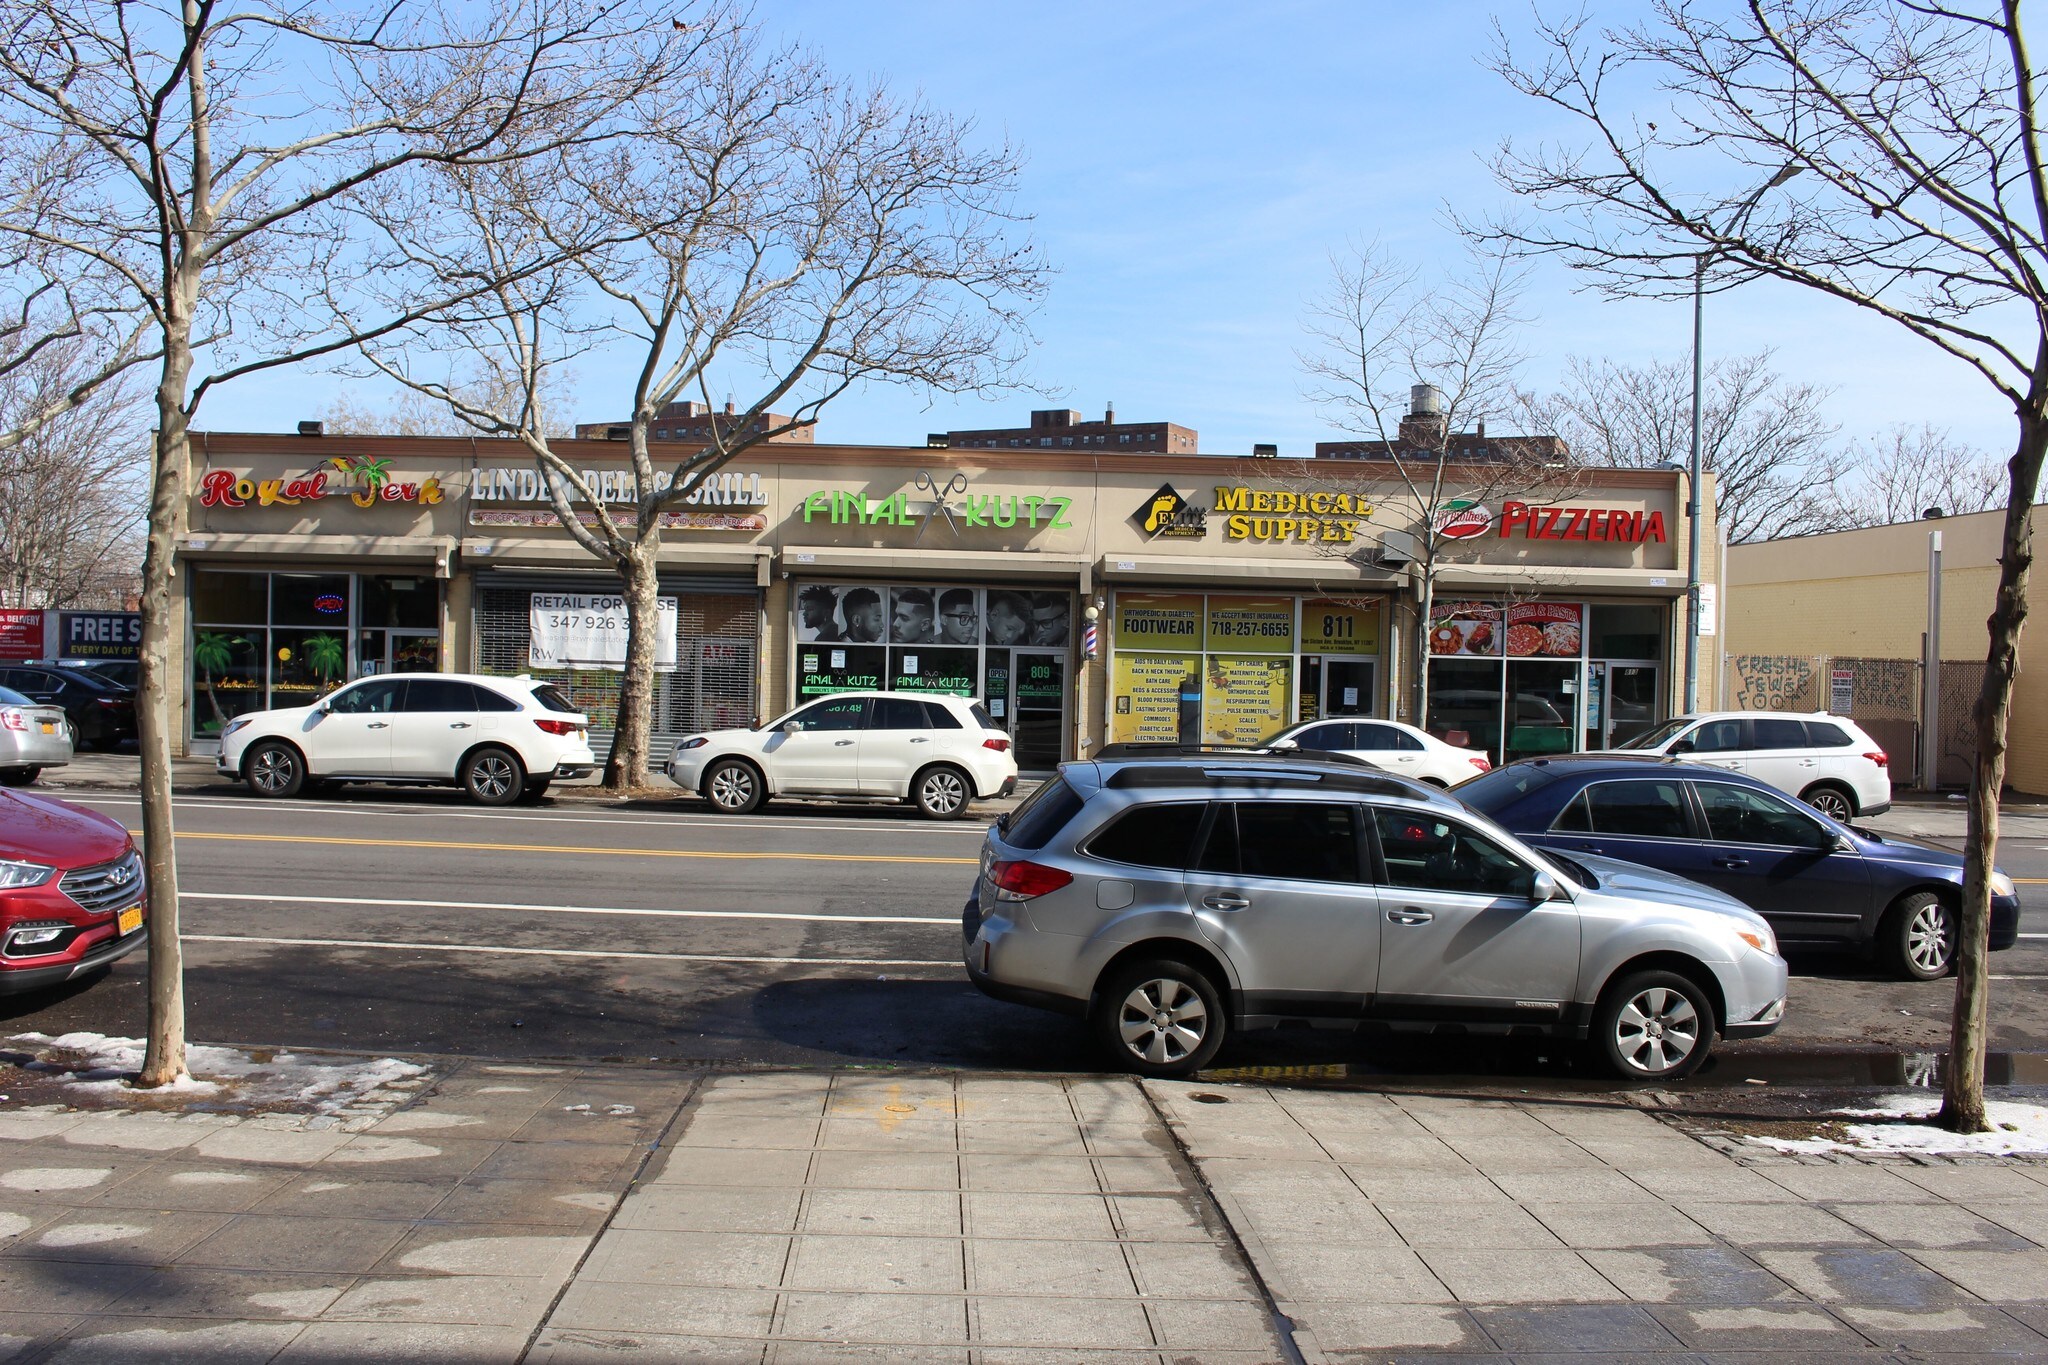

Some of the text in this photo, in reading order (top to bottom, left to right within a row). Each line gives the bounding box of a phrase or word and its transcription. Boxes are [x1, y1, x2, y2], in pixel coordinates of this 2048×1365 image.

[200, 464, 446, 507] Royal Jerk
[581, 469, 638, 503] DEL
[683, 472, 770, 506] GRILL
[1213, 486, 1374, 516] MEDICAL
[804, 490, 1073, 530] FINAL KUTZ
[610, 516, 638, 524] TOBACC
[714, 518, 755, 526] BEVERAGES
[1158, 511, 1208, 525] ELITE
[1498, 501, 1667, 543] PIZZERIA
[1228, 514, 1361, 542] SUPPLY
[314, 599, 344, 609] OPEN
[533, 596, 622, 610] RETAIL FOR
[1124, 609, 1161, 617] ORTHOPEDIC
[1508, 604, 1579, 622] PIZZA & PASTA
[7, 615, 41, 626] DELIVERY
[550, 615, 580, 629] 347
[585, 616, 615, 630] 926
[1123, 618, 1195, 635] FOOTWEAR
[1322, 614, 1353, 638] 811
[71, 617, 123, 641] FREE
[1211, 621, 1290, 637] 718-257-6655
[71, 646, 99, 654] EVERY
[102, 646, 120, 655] DAY
[122, 647, 133, 655] OF
[532, 648, 555, 660] RW
[990, 669, 1007, 678] OPEN
[1031, 666, 1050, 678] 809
[805, 674, 878, 686] FINAL KUTZ
[896, 676, 969, 688] FINAL KUTZ
